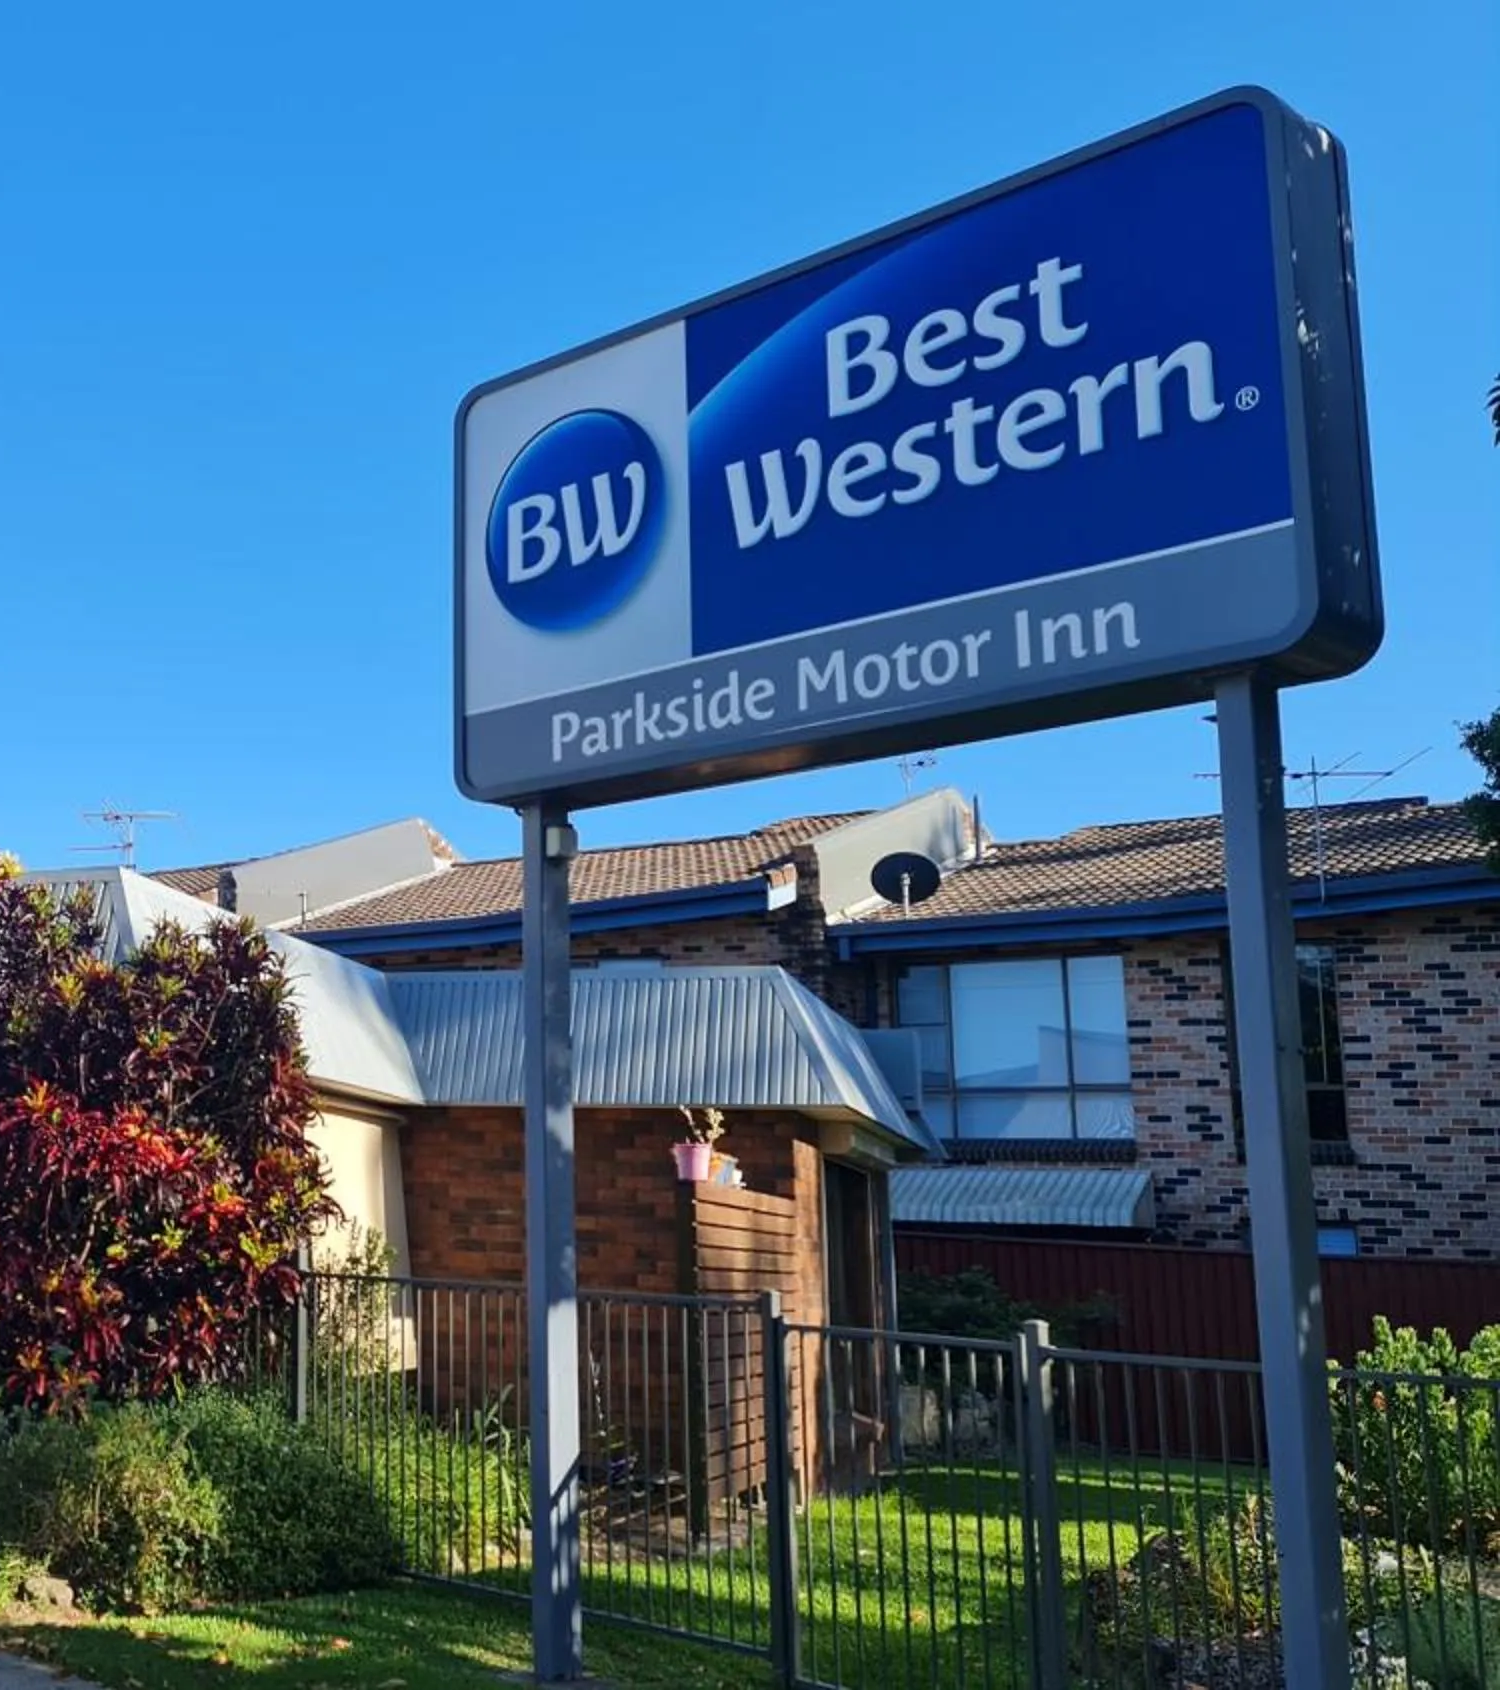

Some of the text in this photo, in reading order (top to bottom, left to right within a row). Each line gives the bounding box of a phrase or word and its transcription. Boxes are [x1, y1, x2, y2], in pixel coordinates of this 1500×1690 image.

[825, 256, 1089, 418] Best
[507, 460, 646, 584] BW
[723, 340, 1226, 549] Western
[550, 601, 1141, 763] Parkside Motor Inn
